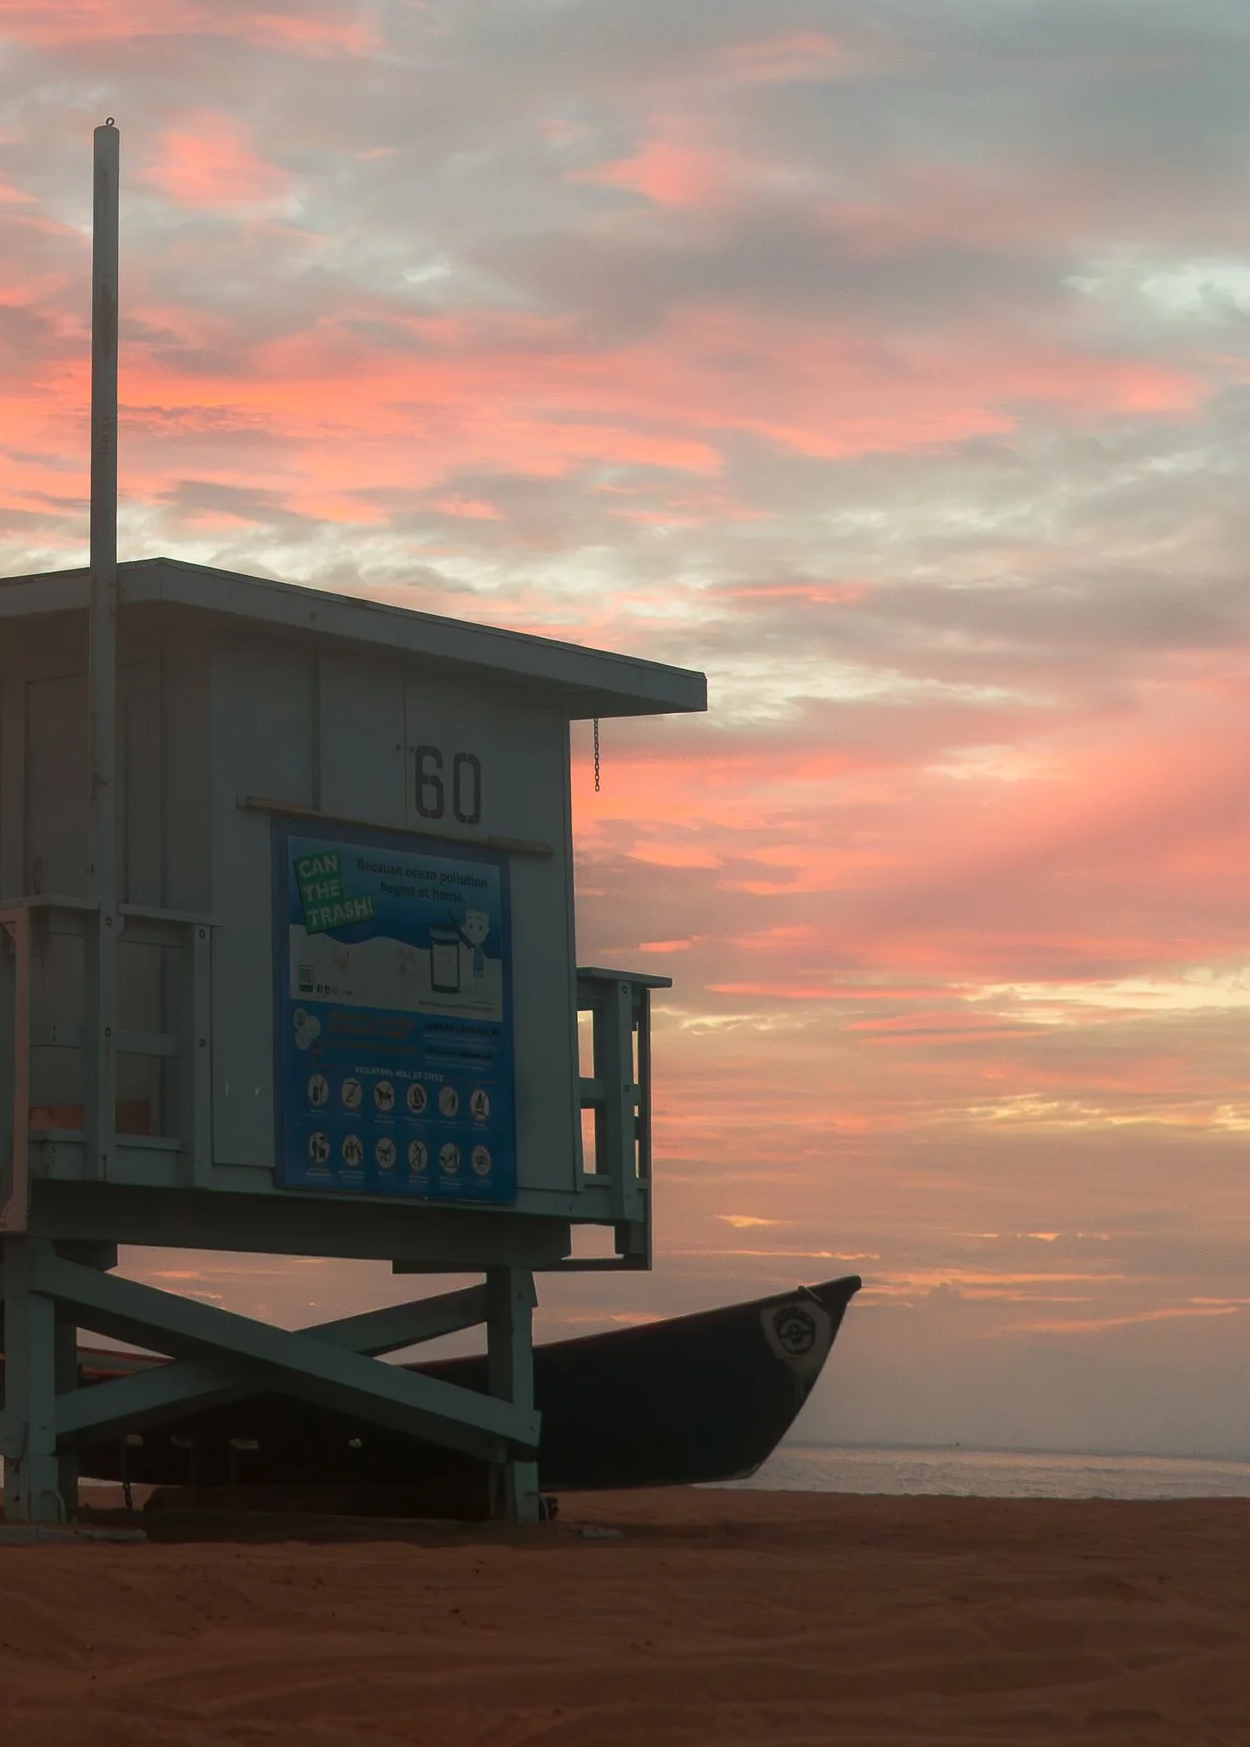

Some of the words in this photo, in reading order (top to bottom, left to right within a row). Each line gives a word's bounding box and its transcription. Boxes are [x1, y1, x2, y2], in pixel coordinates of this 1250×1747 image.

[415, 745, 481, 824] 60
[298, 854, 338, 879] CAN
[405, 868, 437, 881] ocean
[440, 871, 488, 888] pollution
[302, 880, 340, 901] THE
[381, 881, 414, 897] begins
[307, 897, 375, 926] TRASH!
